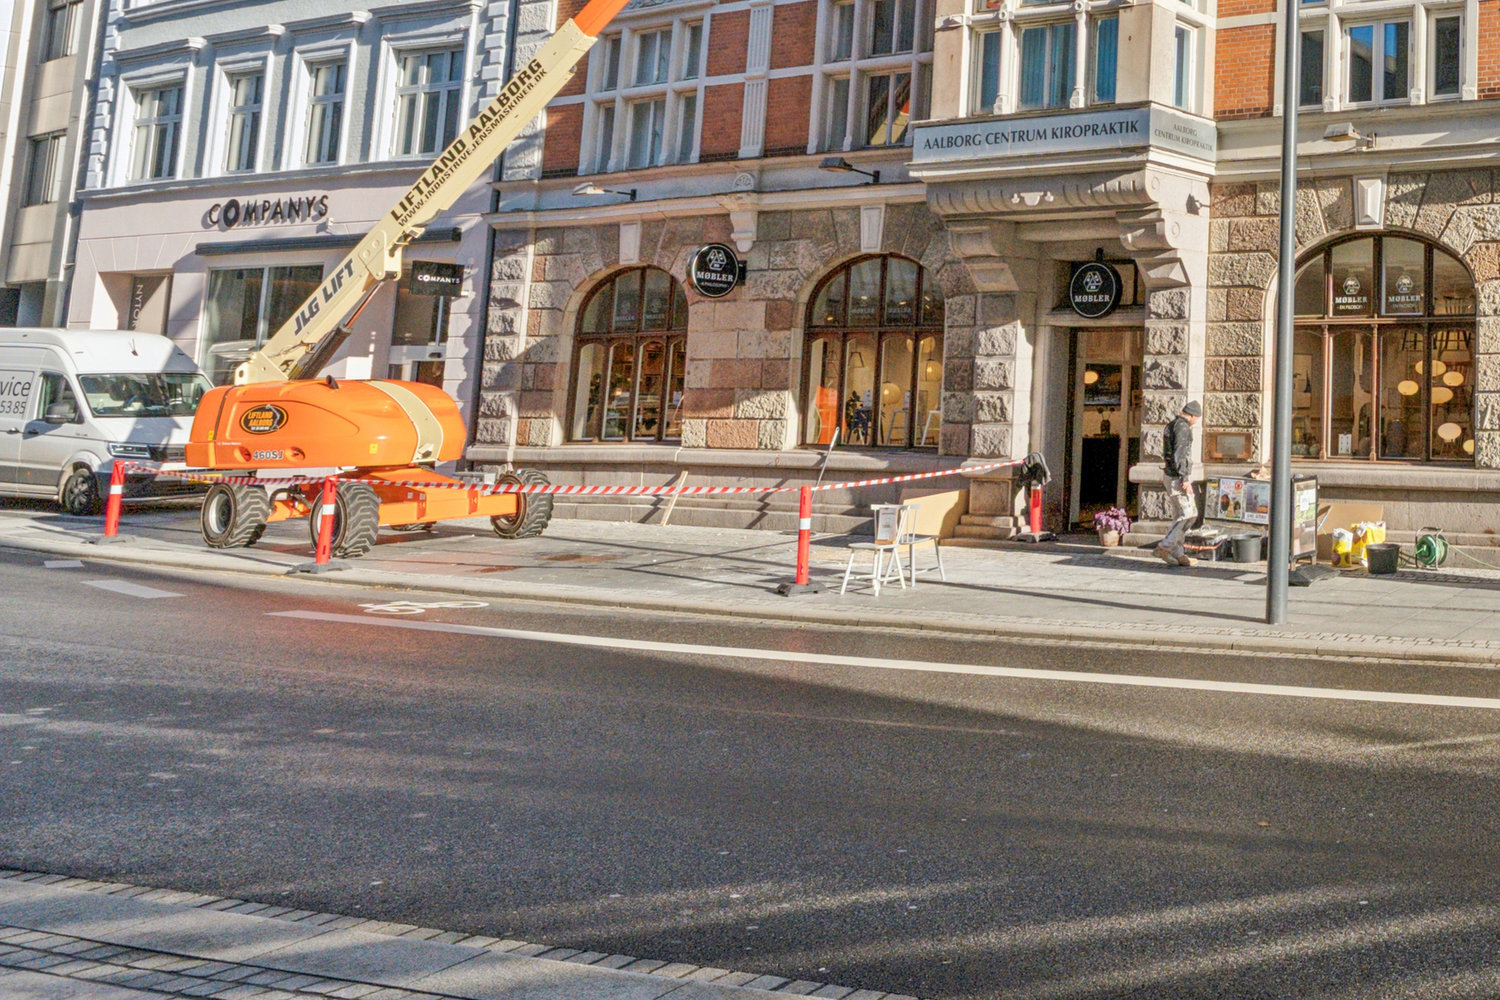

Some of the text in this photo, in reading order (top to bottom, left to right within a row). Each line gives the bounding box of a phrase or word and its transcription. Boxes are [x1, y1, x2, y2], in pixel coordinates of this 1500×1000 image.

[390, 58, 543, 221] LIFTLAND AALBORG
[923, 120, 1139, 150] AALBORG CENTRUM KIROPRAKTIK
[209, 194, 328, 227] COMPANYS
[417, 274, 461, 284] COMPANYS
[696, 271, 734, 282] MØBLER
[294, 258, 354, 336] JLG LIFT
[1075, 294, 1110, 302] MØBLER
[252, 449, 284, 460] 460SJ
